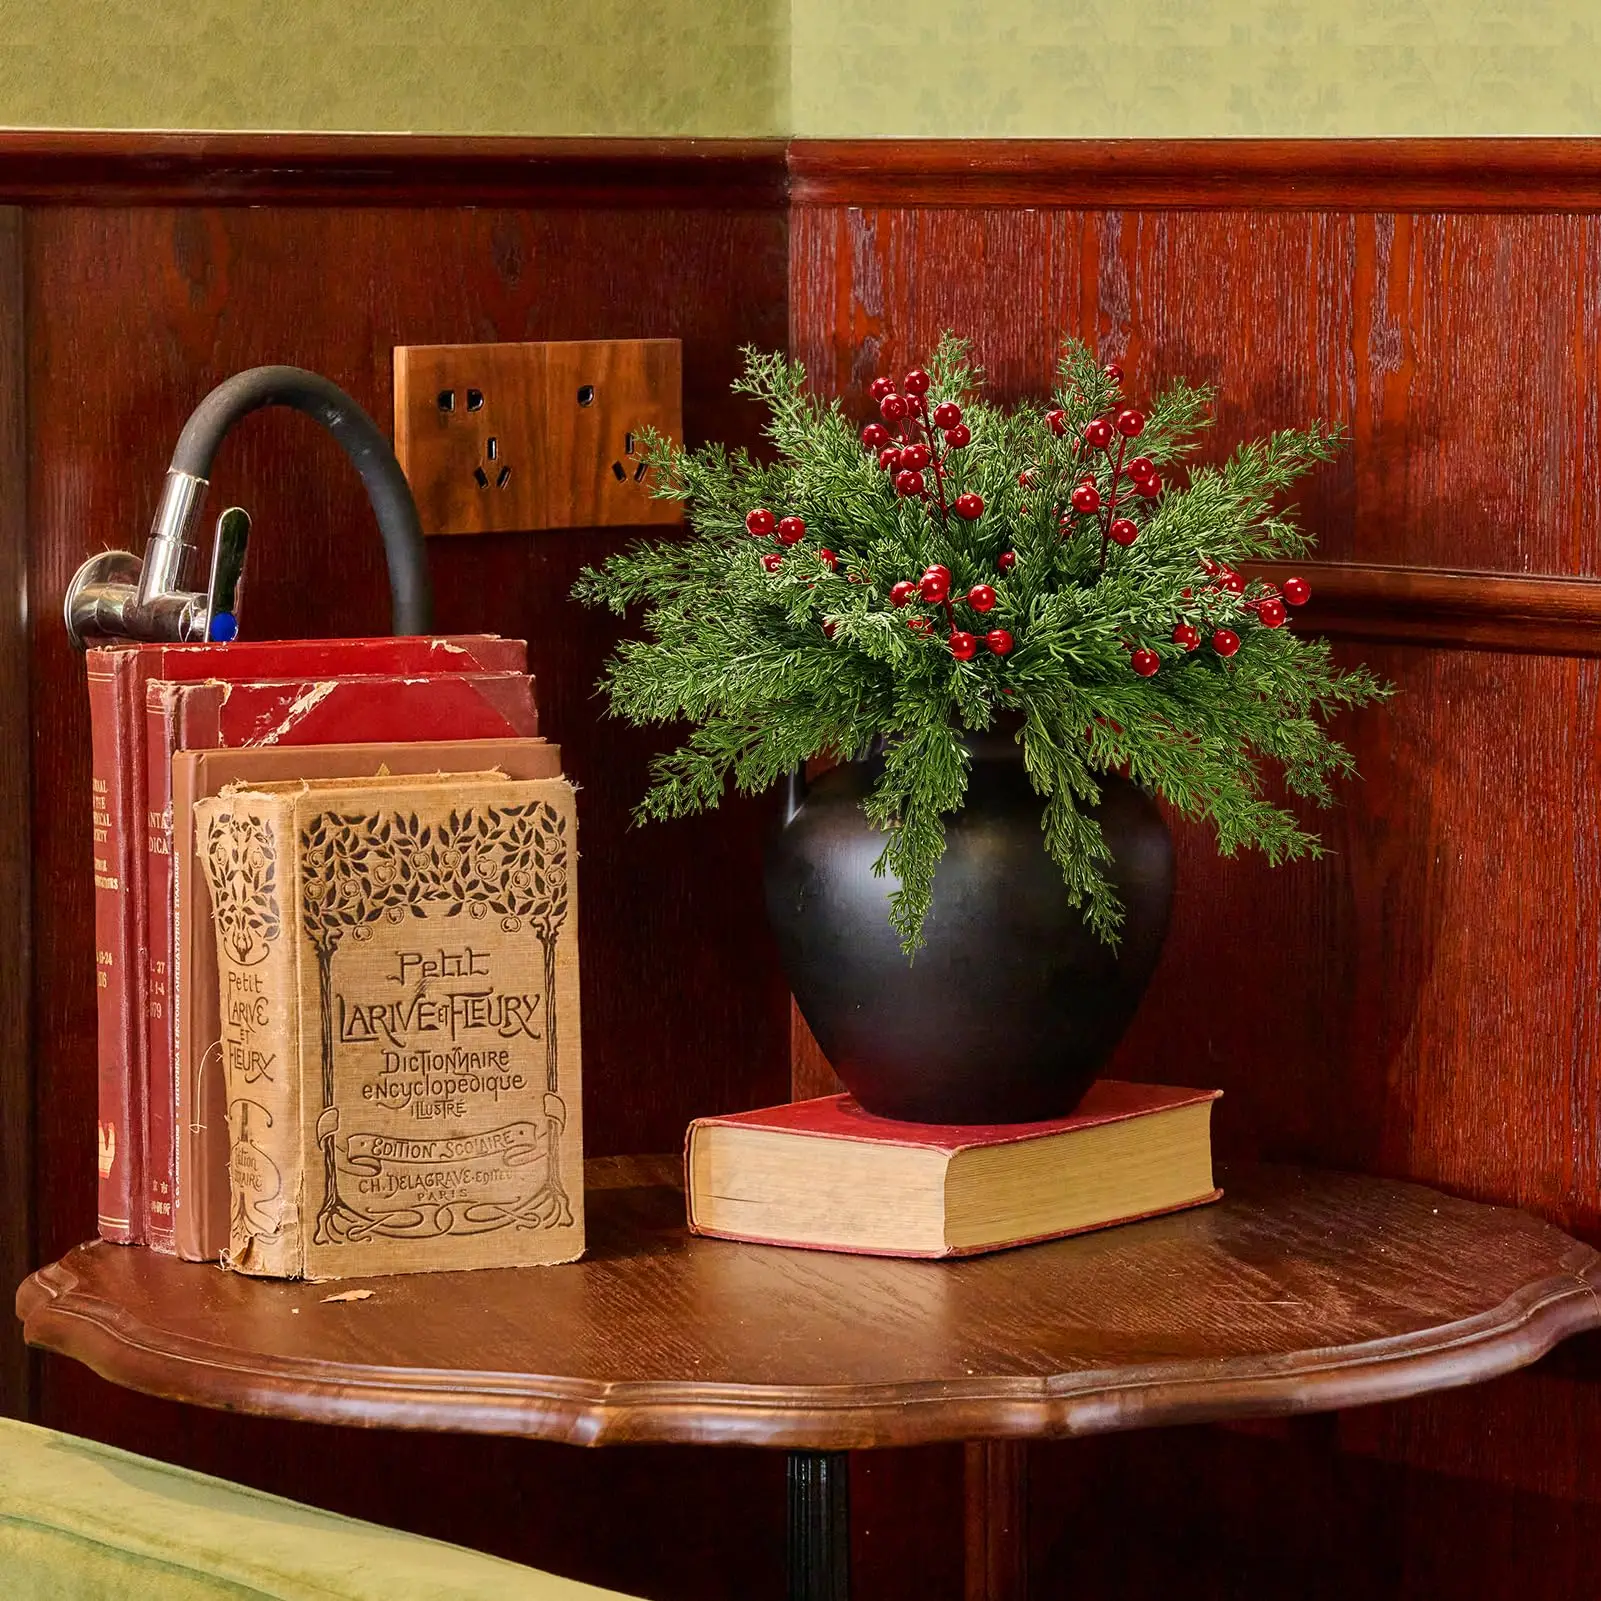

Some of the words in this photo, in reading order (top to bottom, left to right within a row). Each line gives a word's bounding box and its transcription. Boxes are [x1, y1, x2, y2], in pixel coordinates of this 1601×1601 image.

[148, 811, 168, 830] NTA
[148, 836, 169, 855] DICA
[386, 947, 490, 985] Petit
[228, 971, 263, 1000] Petit
[149, 1001, 162, 1019] 79
[227, 994, 269, 1033] LARIVE
[336, 993, 440, 1048] LARIVE
[438, 1003, 450, 1027] ET
[444, 987, 541, 1041] FLEURY
[240, 1028, 250, 1045] ET
[227, 1039, 277, 1086] FLEURY
[358, 1178, 385, 1194] CH.
[475, 1167, 513, 1185] EDITEU
[417, 1188, 468, 1201] PARIS
